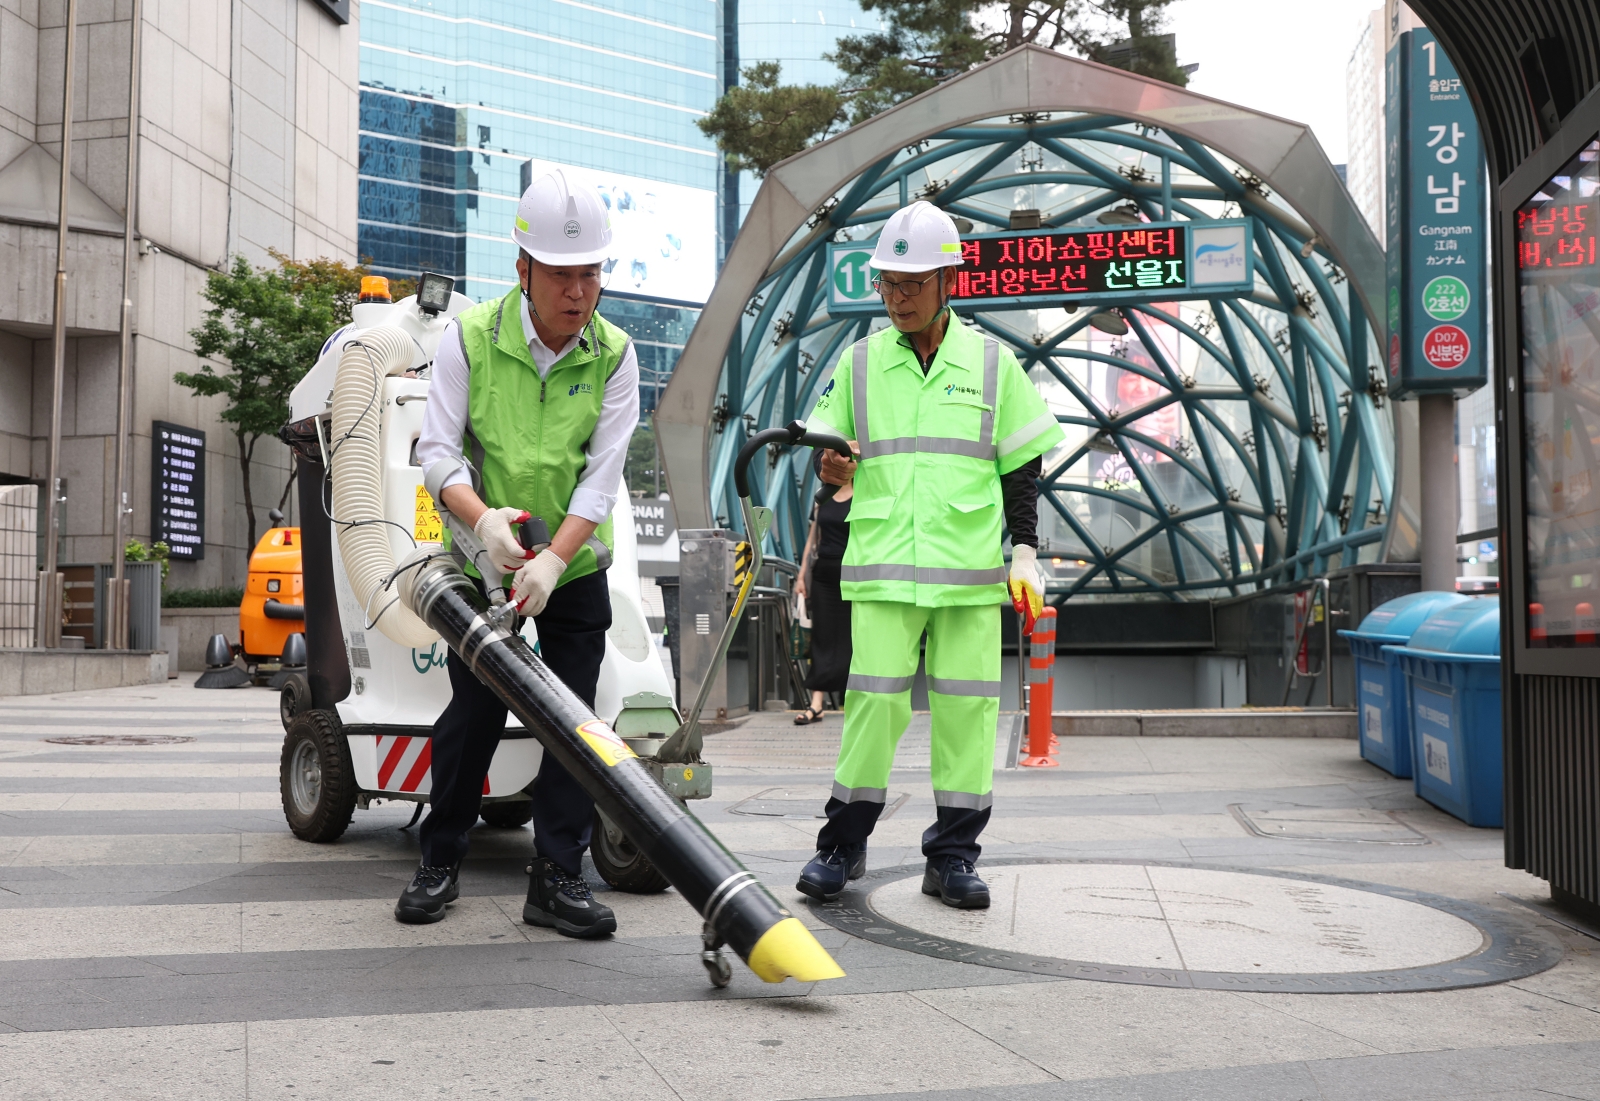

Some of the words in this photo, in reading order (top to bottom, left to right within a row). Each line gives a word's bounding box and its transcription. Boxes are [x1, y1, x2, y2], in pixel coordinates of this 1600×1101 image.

[1428, 79, 1462, 93] 출입구
[1430, 93, 1461, 101] Entrance
[1426, 121, 1467, 214] 강남
[1419, 225, 1473, 237] Gangnam
[998, 228, 1175, 264] 지하쇼핑센터
[1434, 240, 1458, 251] 江南
[1426, 255, 1466, 265] カンナム
[840, 260, 872, 293] 11
[1435, 284, 1457, 295] 222
[1428, 296, 1465, 313] 2호선
[1435, 332, 1458, 343] D07
[1429, 344, 1465, 362] 신분당
[955, 386, 982, 396] 서울특별시
